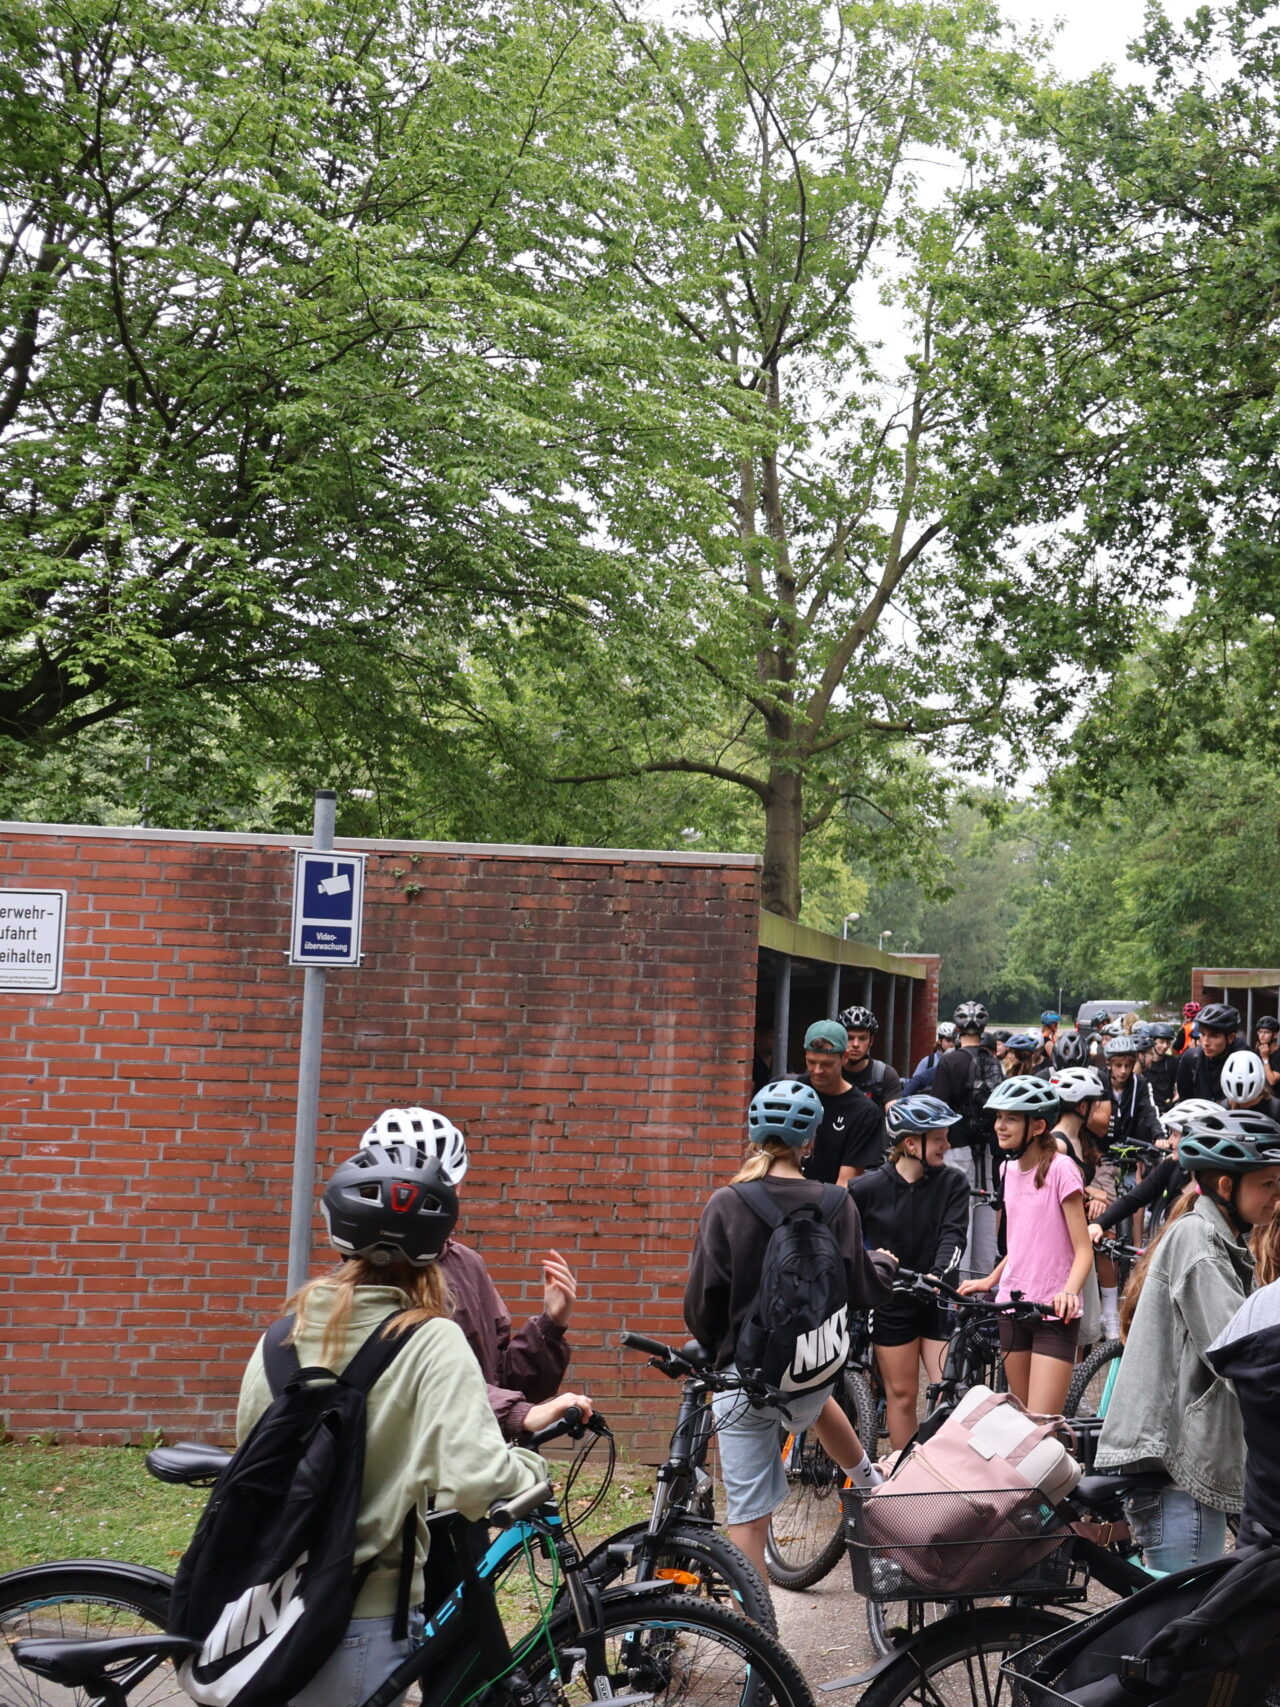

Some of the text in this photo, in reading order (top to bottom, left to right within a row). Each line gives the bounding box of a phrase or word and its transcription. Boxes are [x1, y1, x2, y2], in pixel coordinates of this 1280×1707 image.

[0, 905, 54, 919] erwehr-
[316, 932, 337, 940] Video-
[304, 941, 347, 953] überwachung
[0, 948, 51, 964] eihalten
